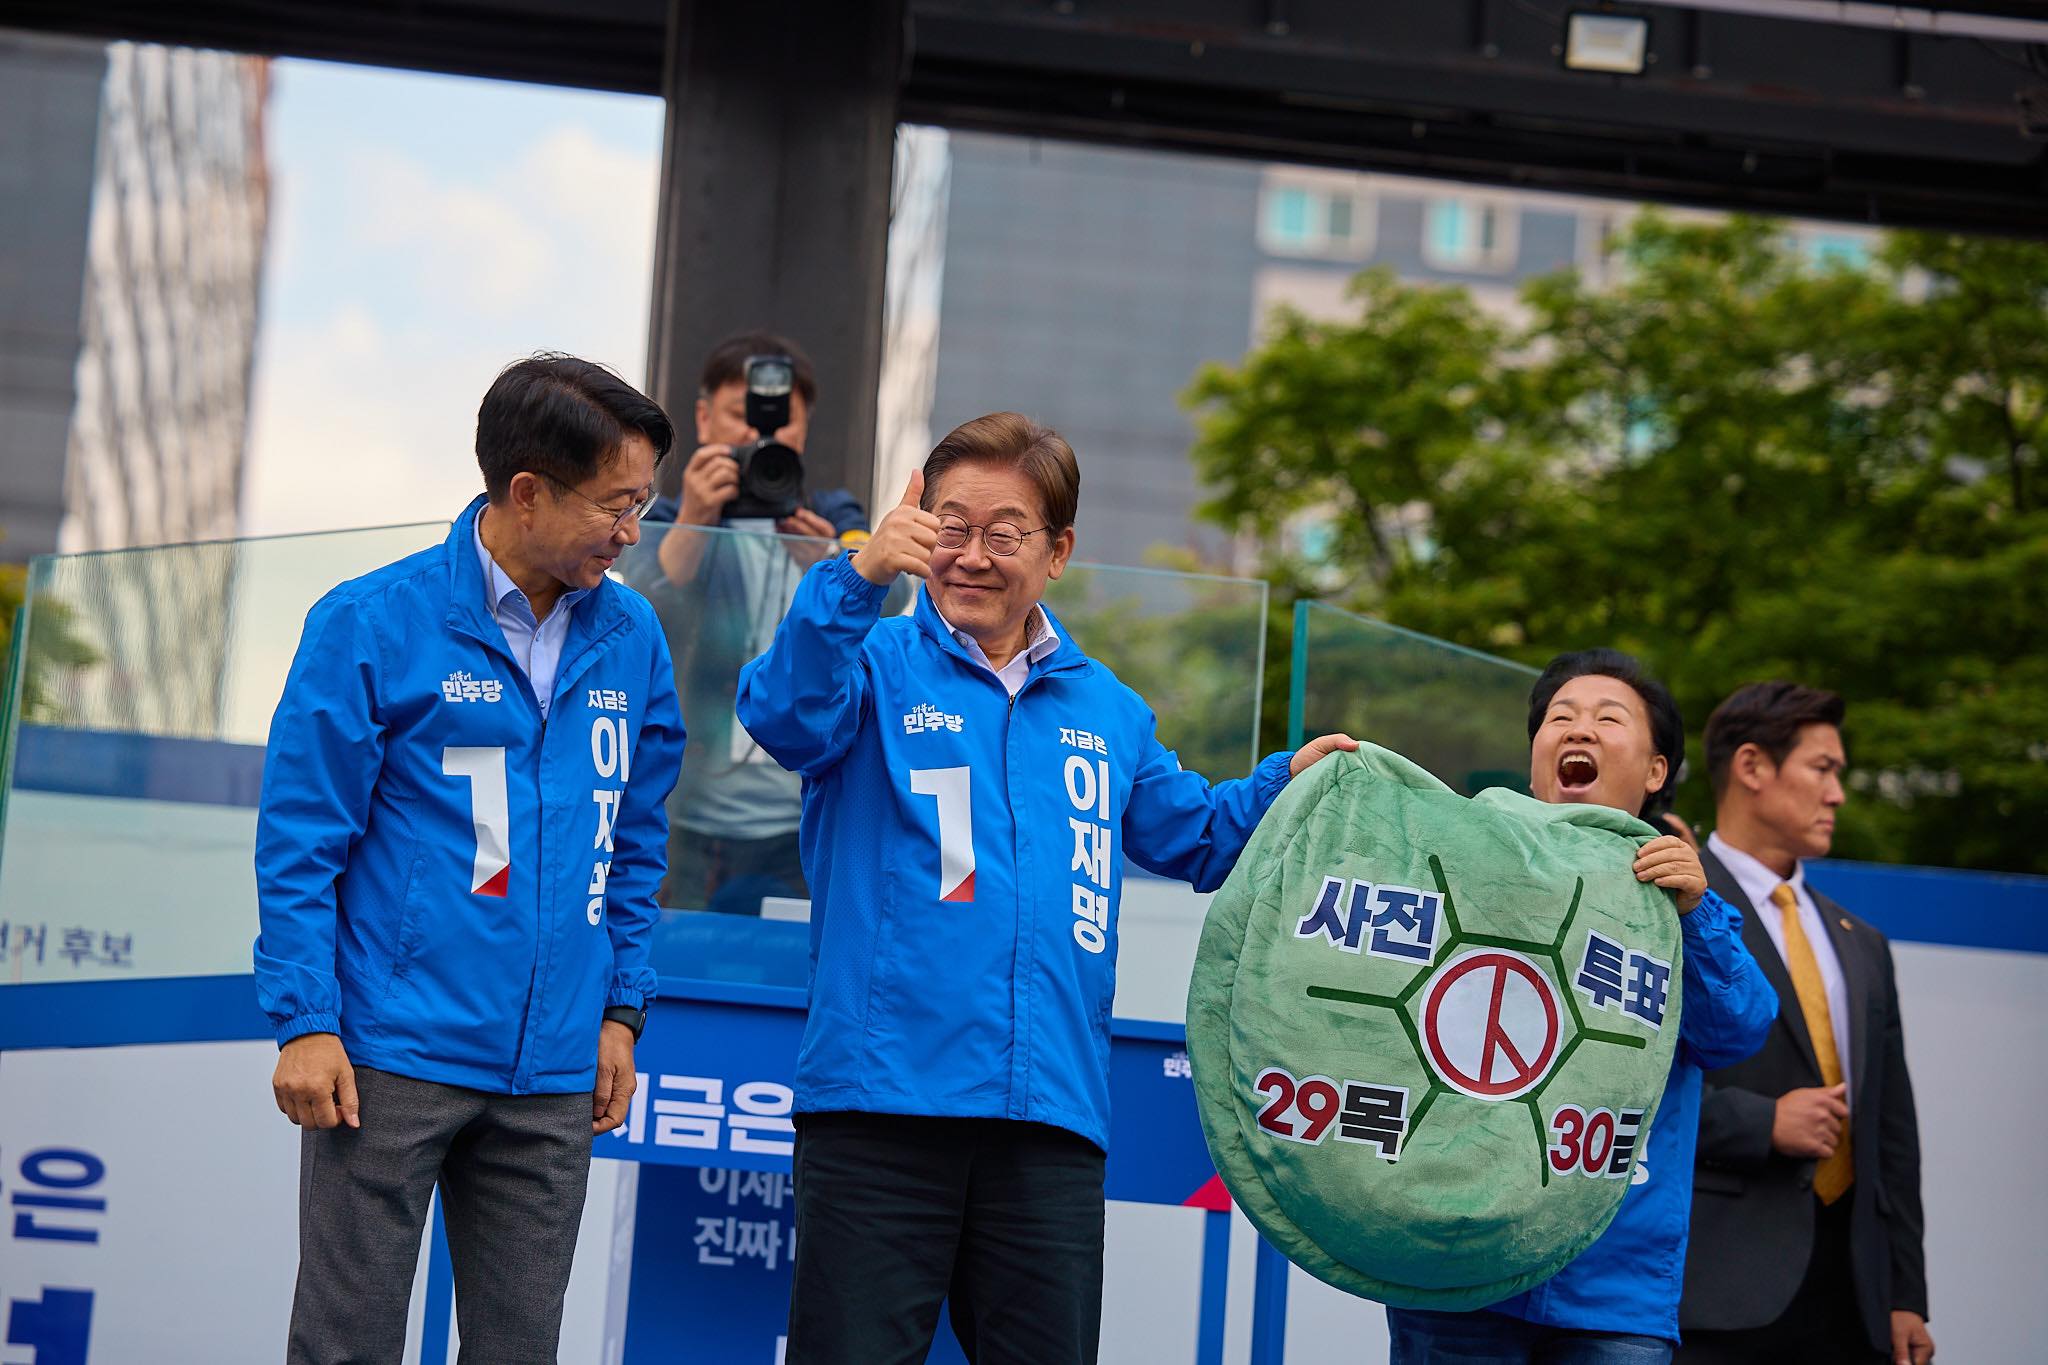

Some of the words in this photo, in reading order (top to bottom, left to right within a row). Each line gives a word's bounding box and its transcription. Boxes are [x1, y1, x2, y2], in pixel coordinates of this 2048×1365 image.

[441, 680, 503, 703] 민주당
[588, 689, 628, 712] 지금은
[903, 712, 964, 735] 민주당
[1059, 728, 1108, 755] 지금은
[442, 746, 510, 898] 1
[910, 766, 976, 903] 1
[1063, 755, 1112, 954] 이재명
[1298, 879, 1443, 962] 사전
[1578, 934, 1669, 1026] 투표
[1163, 1057, 1192, 1079] 민주
[1257, 1072, 1406, 1156] 29목
[0, 1146, 107, 1245] 은
[699, 1168, 794, 1209] 이제
[694, 1217, 782, 1270] 진짜
